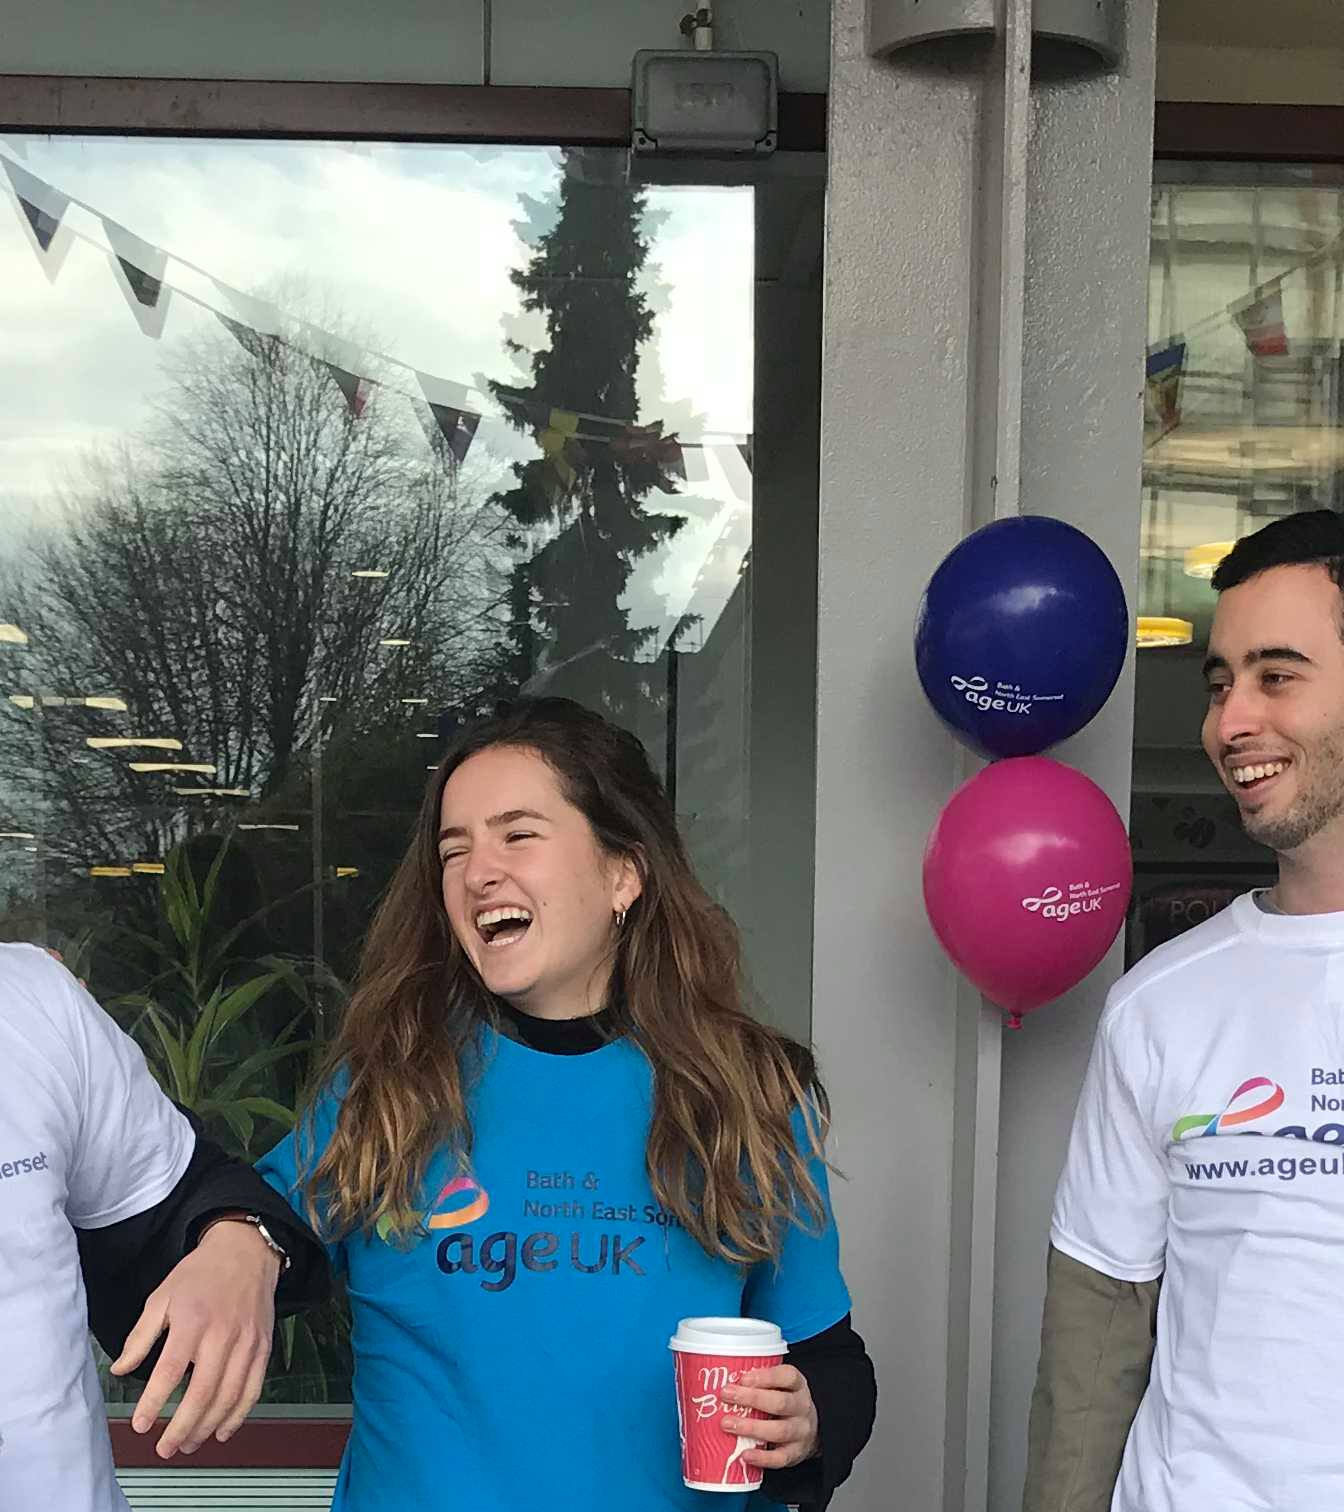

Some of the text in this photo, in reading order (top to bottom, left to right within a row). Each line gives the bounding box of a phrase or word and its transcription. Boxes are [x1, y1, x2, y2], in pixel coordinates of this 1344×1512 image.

[526, 1170, 600, 1191] Bath &
[523, 1199, 584, 1220] North
[591, 1201, 638, 1223] East
[436, 1230, 647, 1293] age UK
